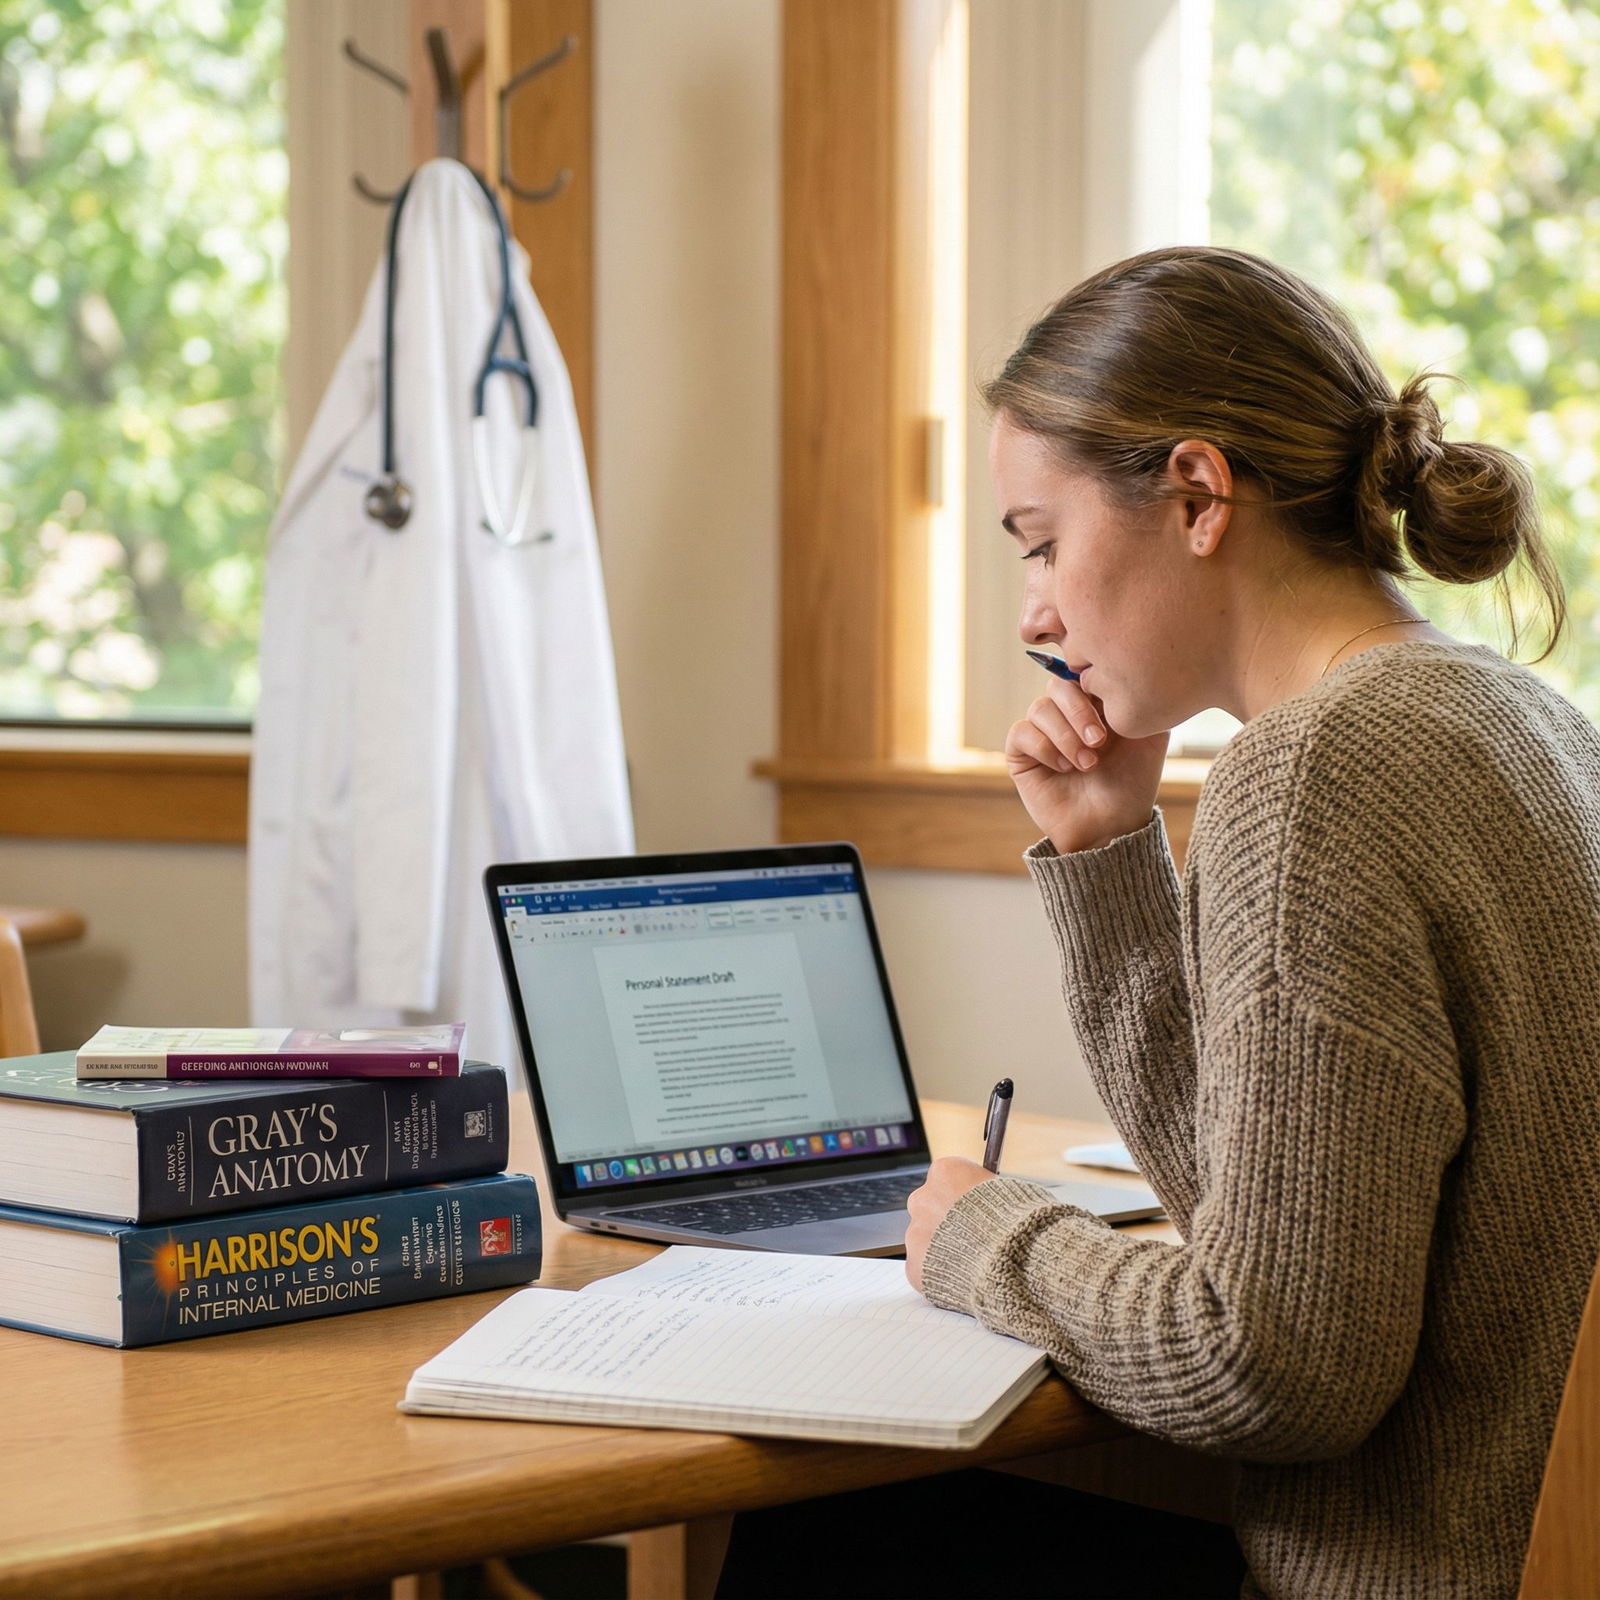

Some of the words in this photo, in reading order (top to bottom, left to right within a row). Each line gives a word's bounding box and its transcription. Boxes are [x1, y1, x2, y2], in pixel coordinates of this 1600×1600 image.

[625, 975, 664, 991] Personal
[664, 973, 711, 988] Statement
[711, 970, 736, 984] Draft
[207, 1102, 339, 1157] GRAY'S
[207, 1144, 371, 1199] ANATOMY
[176, 1215, 380, 1282] HARRISON'S
[179, 1265, 335, 1303] PRINCIPLES
[350, 1258, 381, 1276] OF
[179, 1293, 281, 1326] INTERNAL
[286, 1276, 382, 1309] MEDICINE
